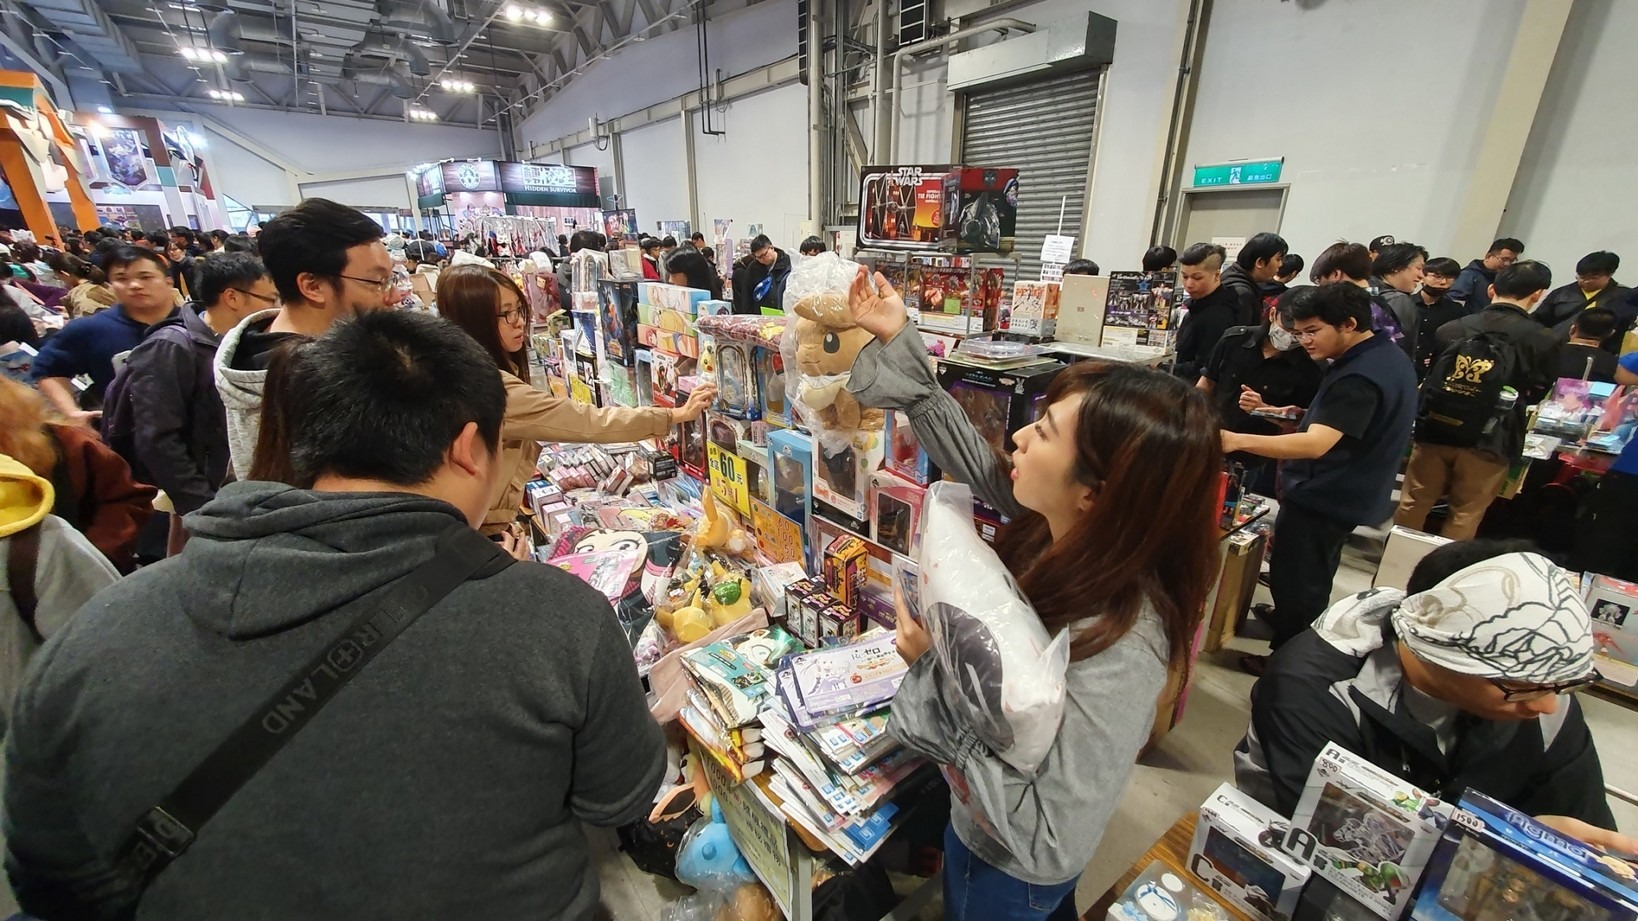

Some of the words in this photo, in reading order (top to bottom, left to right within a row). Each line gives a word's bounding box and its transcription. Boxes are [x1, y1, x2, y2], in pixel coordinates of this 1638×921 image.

[898, 167, 922, 177] STAR
[893, 176, 923, 186] WARS
[1321, 759, 1339, 773] 800
[1456, 812, 1479, 828] 1500
[1508, 812, 1588, 859] figma
